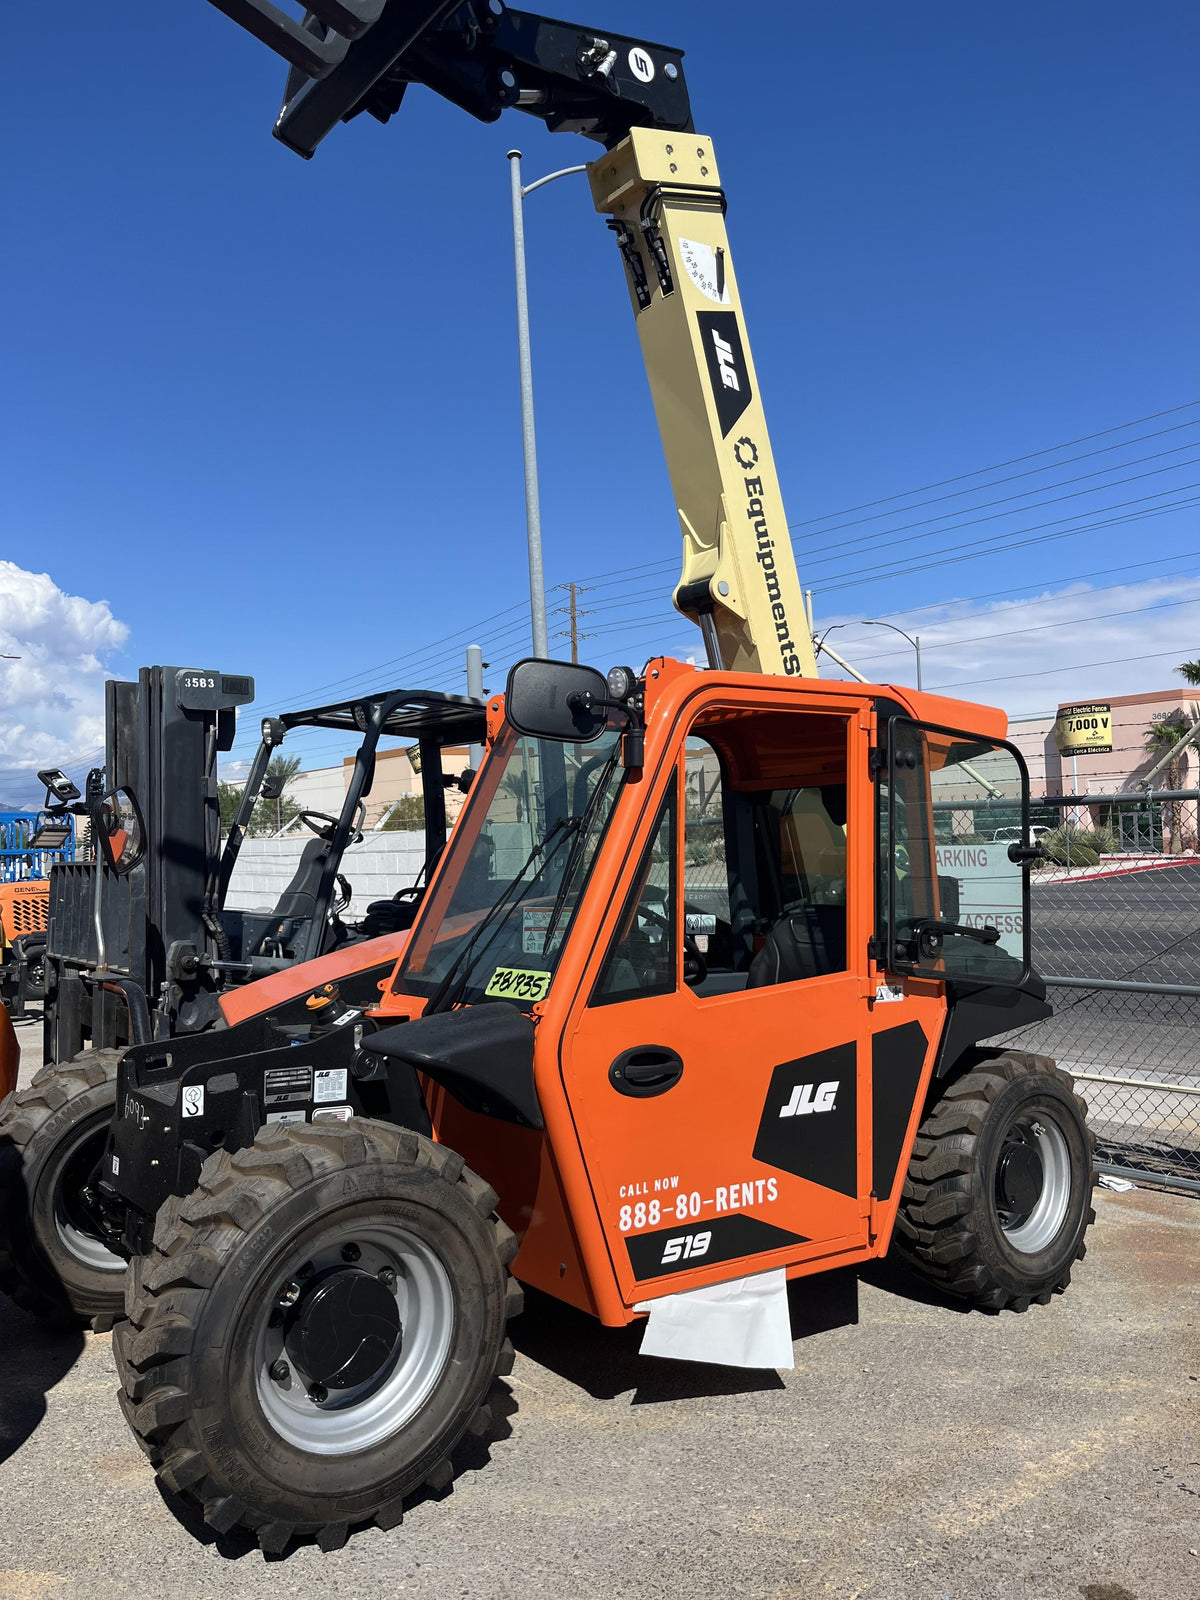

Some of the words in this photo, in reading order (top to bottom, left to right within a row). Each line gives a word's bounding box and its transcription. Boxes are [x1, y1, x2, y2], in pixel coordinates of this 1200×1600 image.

[711, 328, 740, 391] JLG
[744, 475, 803, 678] EquipmentS
[184, 678, 215, 688] 3583
[1072, 706, 1092, 715] Electric
[1091, 705, 1108, 713] Fence
[1067, 718, 1098, 733] 7,000
[1101, 717, 1109, 729] V
[935, 849, 988, 867] ARKING
[274, 1094, 289, 1102] JLG
[779, 1081, 840, 1118] JLG
[619, 1182, 649, 1198] CALL
[654, 1175, 680, 1191] NOW
[618, 1177, 779, 1232] 888-80-RENTS
[660, 1231, 712, 1264] 519
